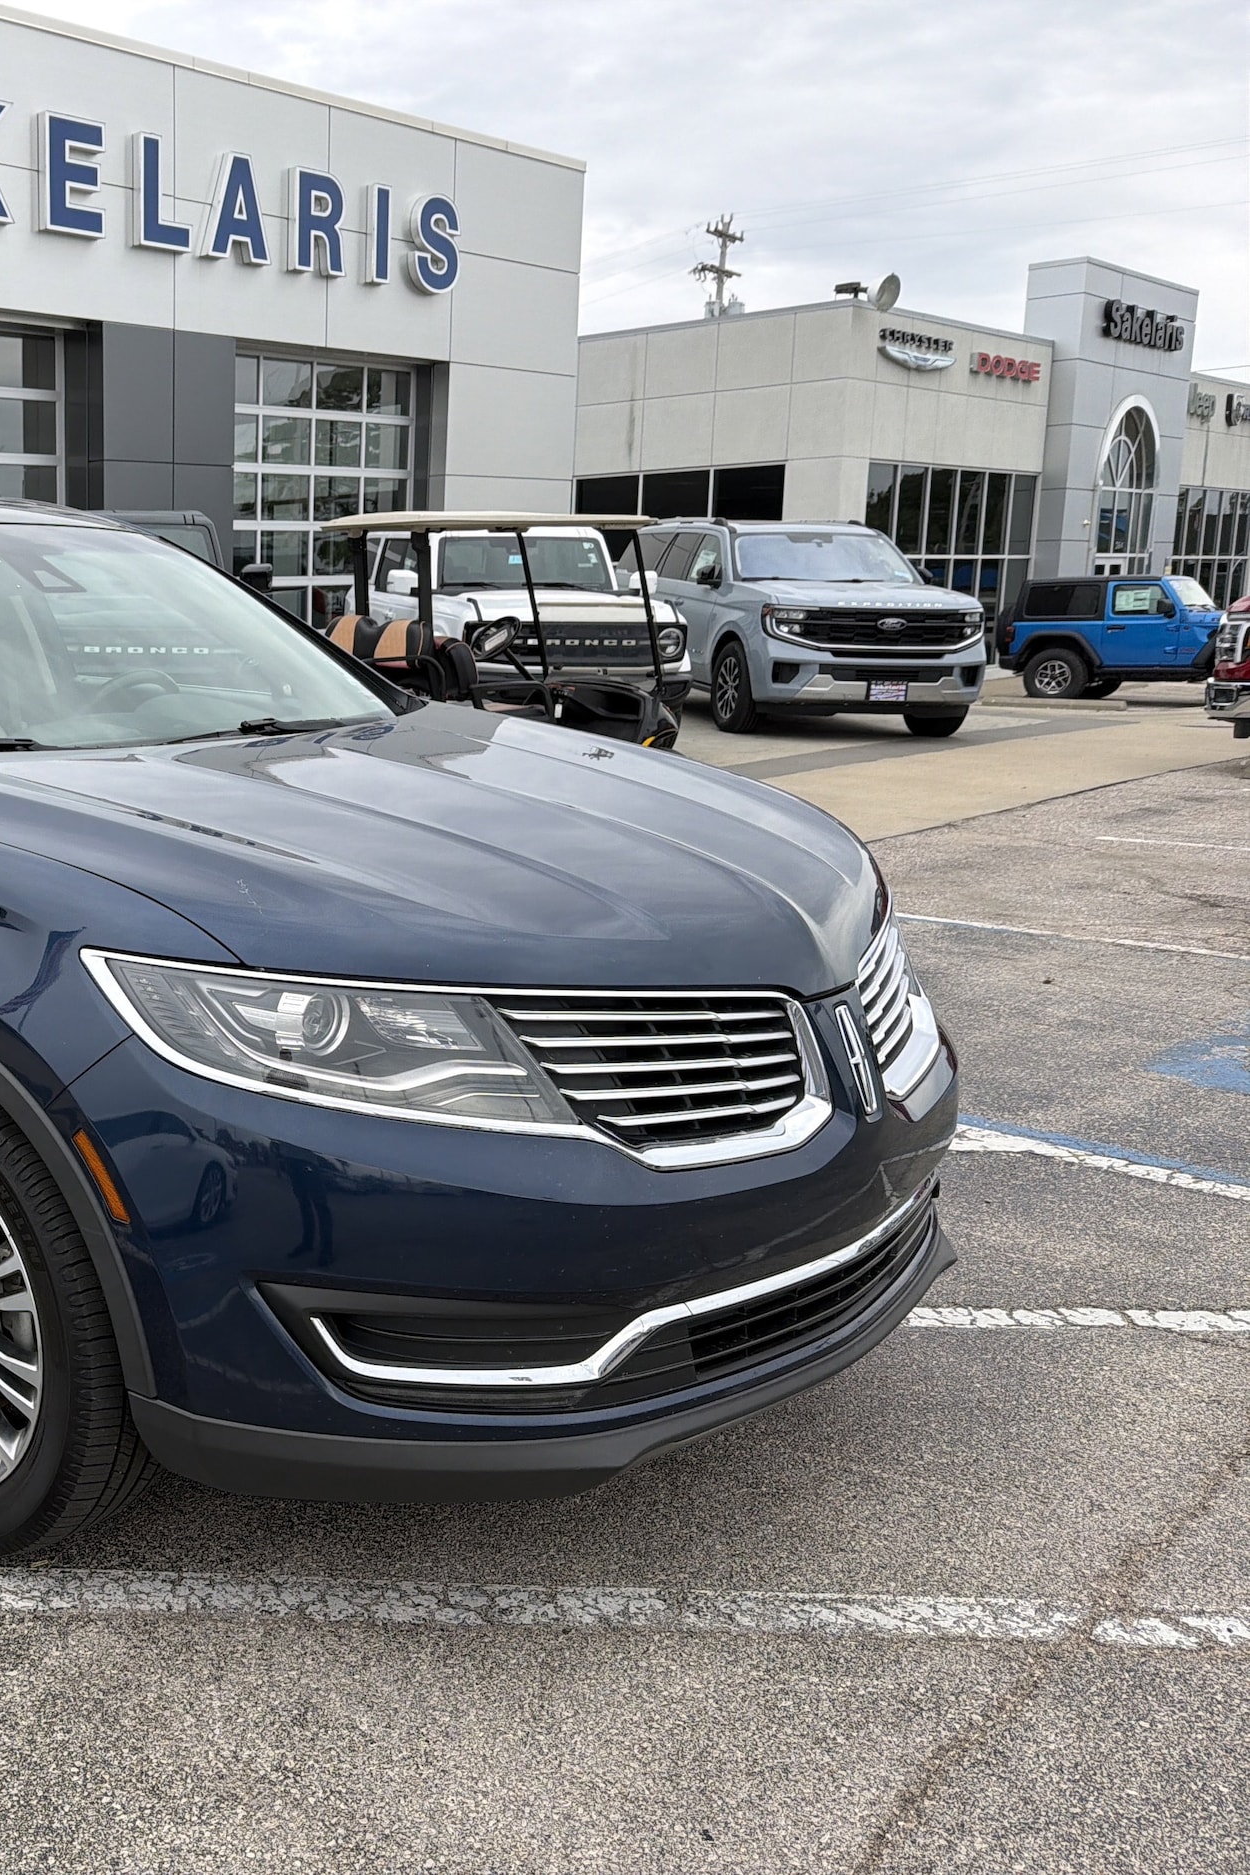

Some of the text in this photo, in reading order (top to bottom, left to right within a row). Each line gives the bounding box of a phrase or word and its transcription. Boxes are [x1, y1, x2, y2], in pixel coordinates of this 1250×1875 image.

[879, 327, 954, 352] CHRYSLER
[1103, 299, 1185, 351] Sakelaris
[971, 351, 1042, 382] DODGE
[1187, 382, 1217, 424] Jeep
[83, 645, 210, 654] BRONCO
